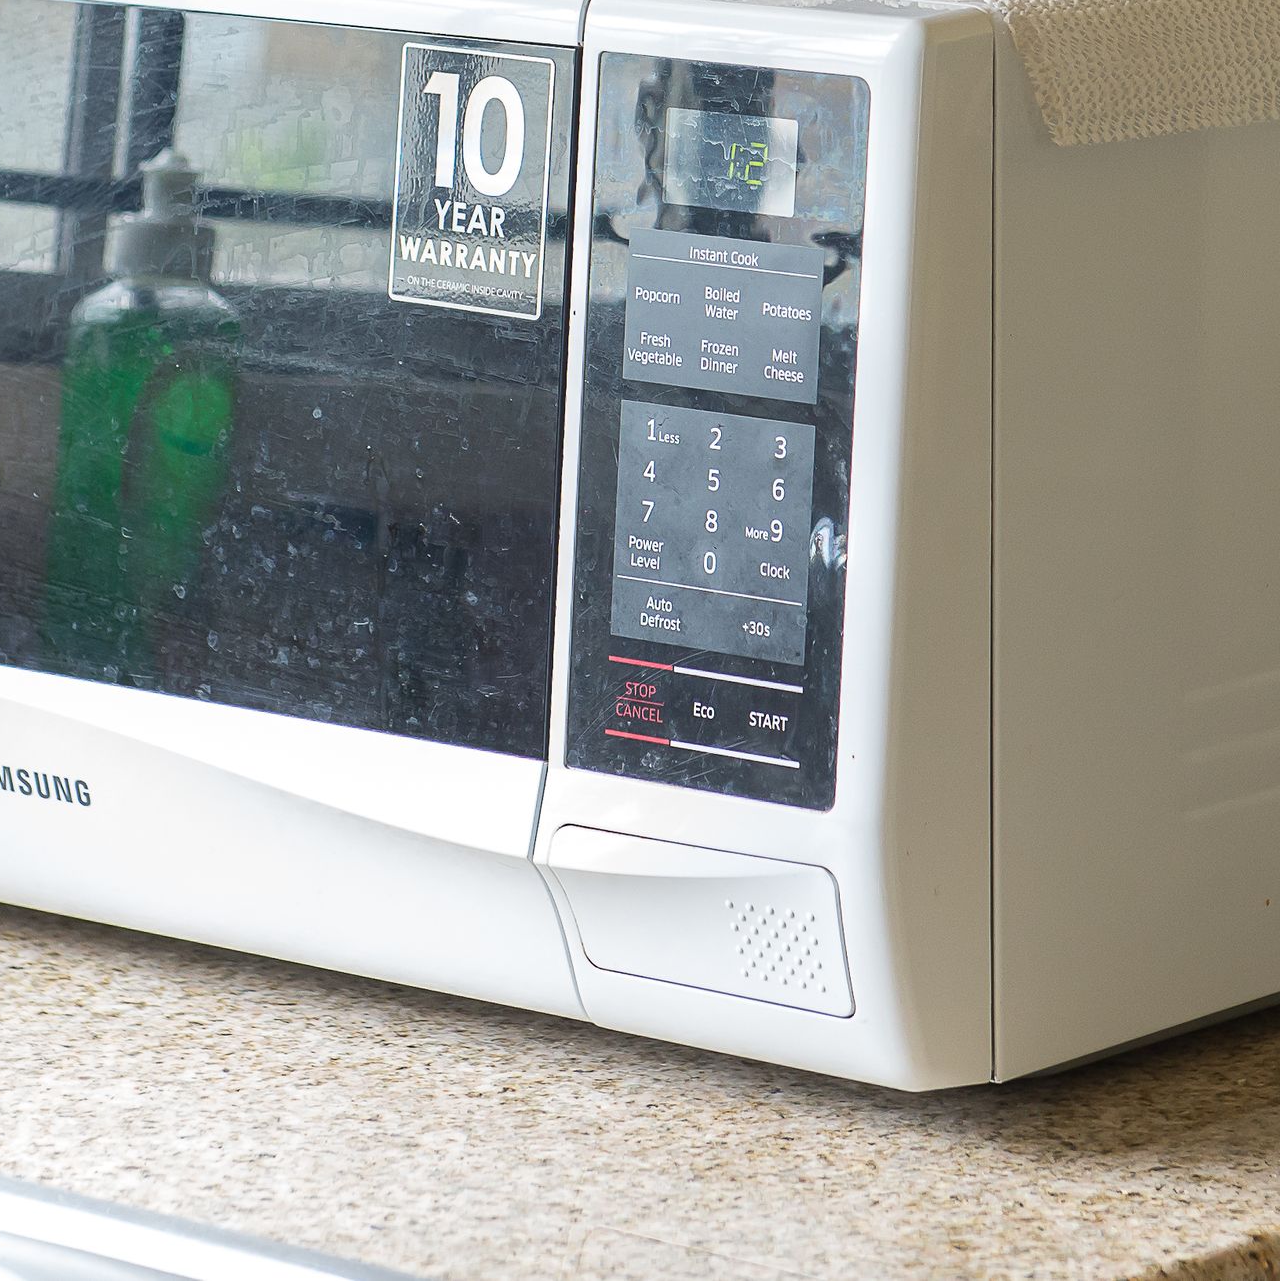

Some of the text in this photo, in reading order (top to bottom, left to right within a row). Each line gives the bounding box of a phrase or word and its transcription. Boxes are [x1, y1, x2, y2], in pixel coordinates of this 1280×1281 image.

[423, 70, 526, 198] 10
[434, 198, 507, 239] YEAR
[399, 234, 537, 279] WARRANTY
[689, 246, 760, 267] Instant Cook
[406, 275, 524, 300] ON THE CERAMIC INSIDE CAVITY
[635, 286, 681, 306] Popcorn
[704, 286, 741, 304] Boiled
[704, 304, 739, 321] Water
[762, 302, 812, 322] Potatoes
[640, 331, 671, 349] Fresh
[700, 339, 740, 357] Frozen
[628, 347, 683, 368] Vegetable
[700, 357, 739, 375] Dinner
[772, 348, 798, 365] Melt
[763, 365, 805, 384] Cheese
[646, 419, 681, 446] 1 Less
[708, 427, 723, 451] 2
[773, 436, 788, 460] 3
[642, 460, 657, 484] 4
[707, 468, 721, 493] 5
[771, 477, 786, 502] 6
[641, 500, 655, 524] 7
[704, 509, 719, 534] 8
[745, 519, 784, 543] More 9
[628, 535, 665, 555] Power
[630, 553, 661, 572] Level
[703, 550, 717, 575] 0
[759, 561, 791, 581] Clock
[645, 595, 674, 614] Auto
[640, 611, 682, 633] Defrost
[741, 621, 772, 638] +30s
[624, 680, 658, 700] STOP
[615, 701, 664, 725] CANCEL
[692, 701, 716, 721] Eco
[748, 710, 789, 734] START
